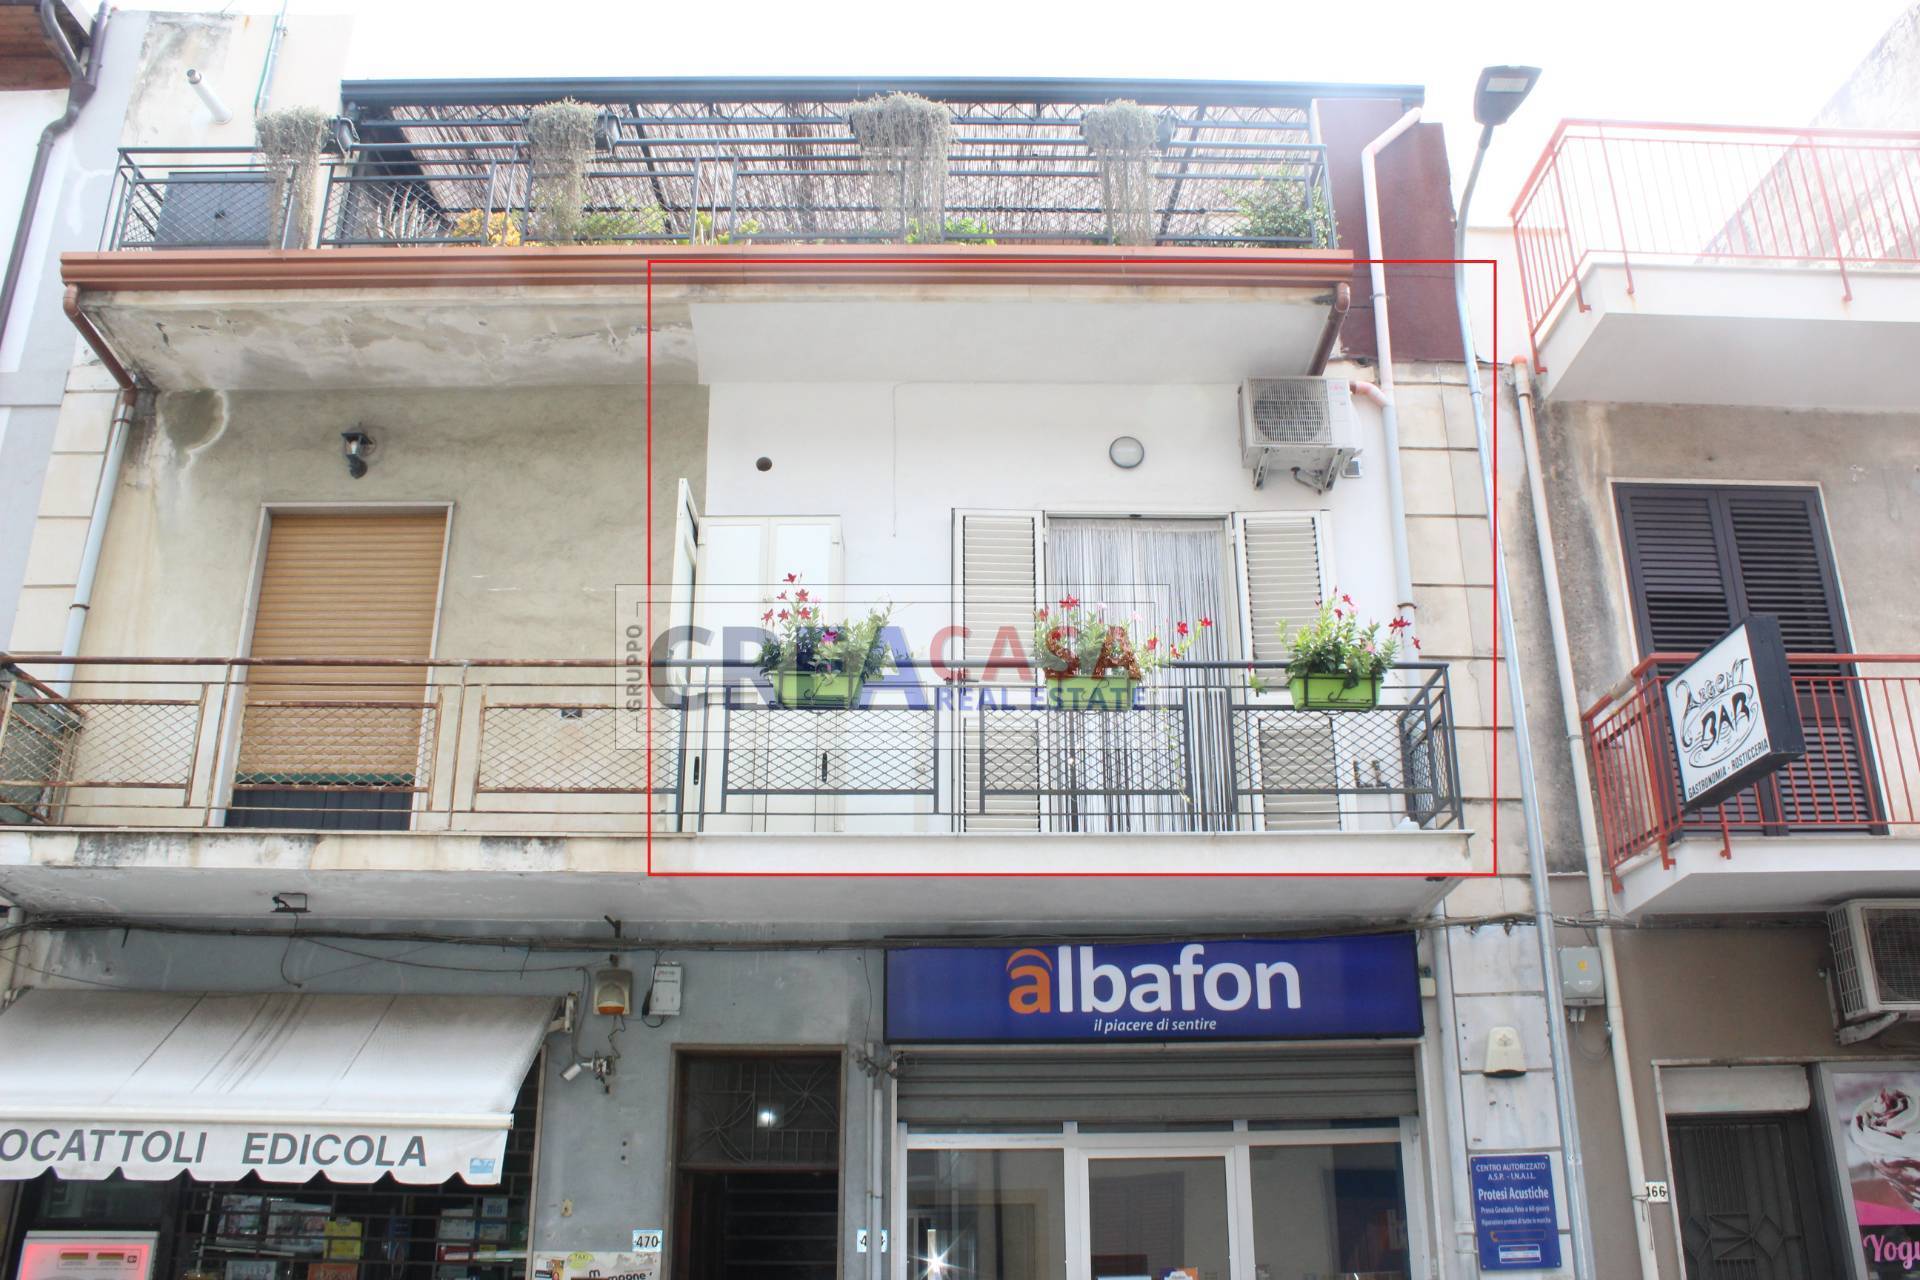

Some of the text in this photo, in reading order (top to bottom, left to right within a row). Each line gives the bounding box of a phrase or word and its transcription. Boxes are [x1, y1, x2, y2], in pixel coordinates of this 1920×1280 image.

[1702, 691, 1751, 751] BAR
[1688, 766, 1727, 799] GASTRONOMIA
[1731, 738, 1769, 770] ROSTICCERIA
[1007, 944, 1301, 1014] albafon
[1094, 1017, 1217, 1035] il piacere di sentire
[0, 1128, 428, 1167] OCATTOLI EDICOLA
[1475, 1162, 1546, 1172] CENTRO AUTORIZZATO
[1478, 1185, 1549, 1201] Protesi Acustiche
[636, 1235, 660, 1248] 470
